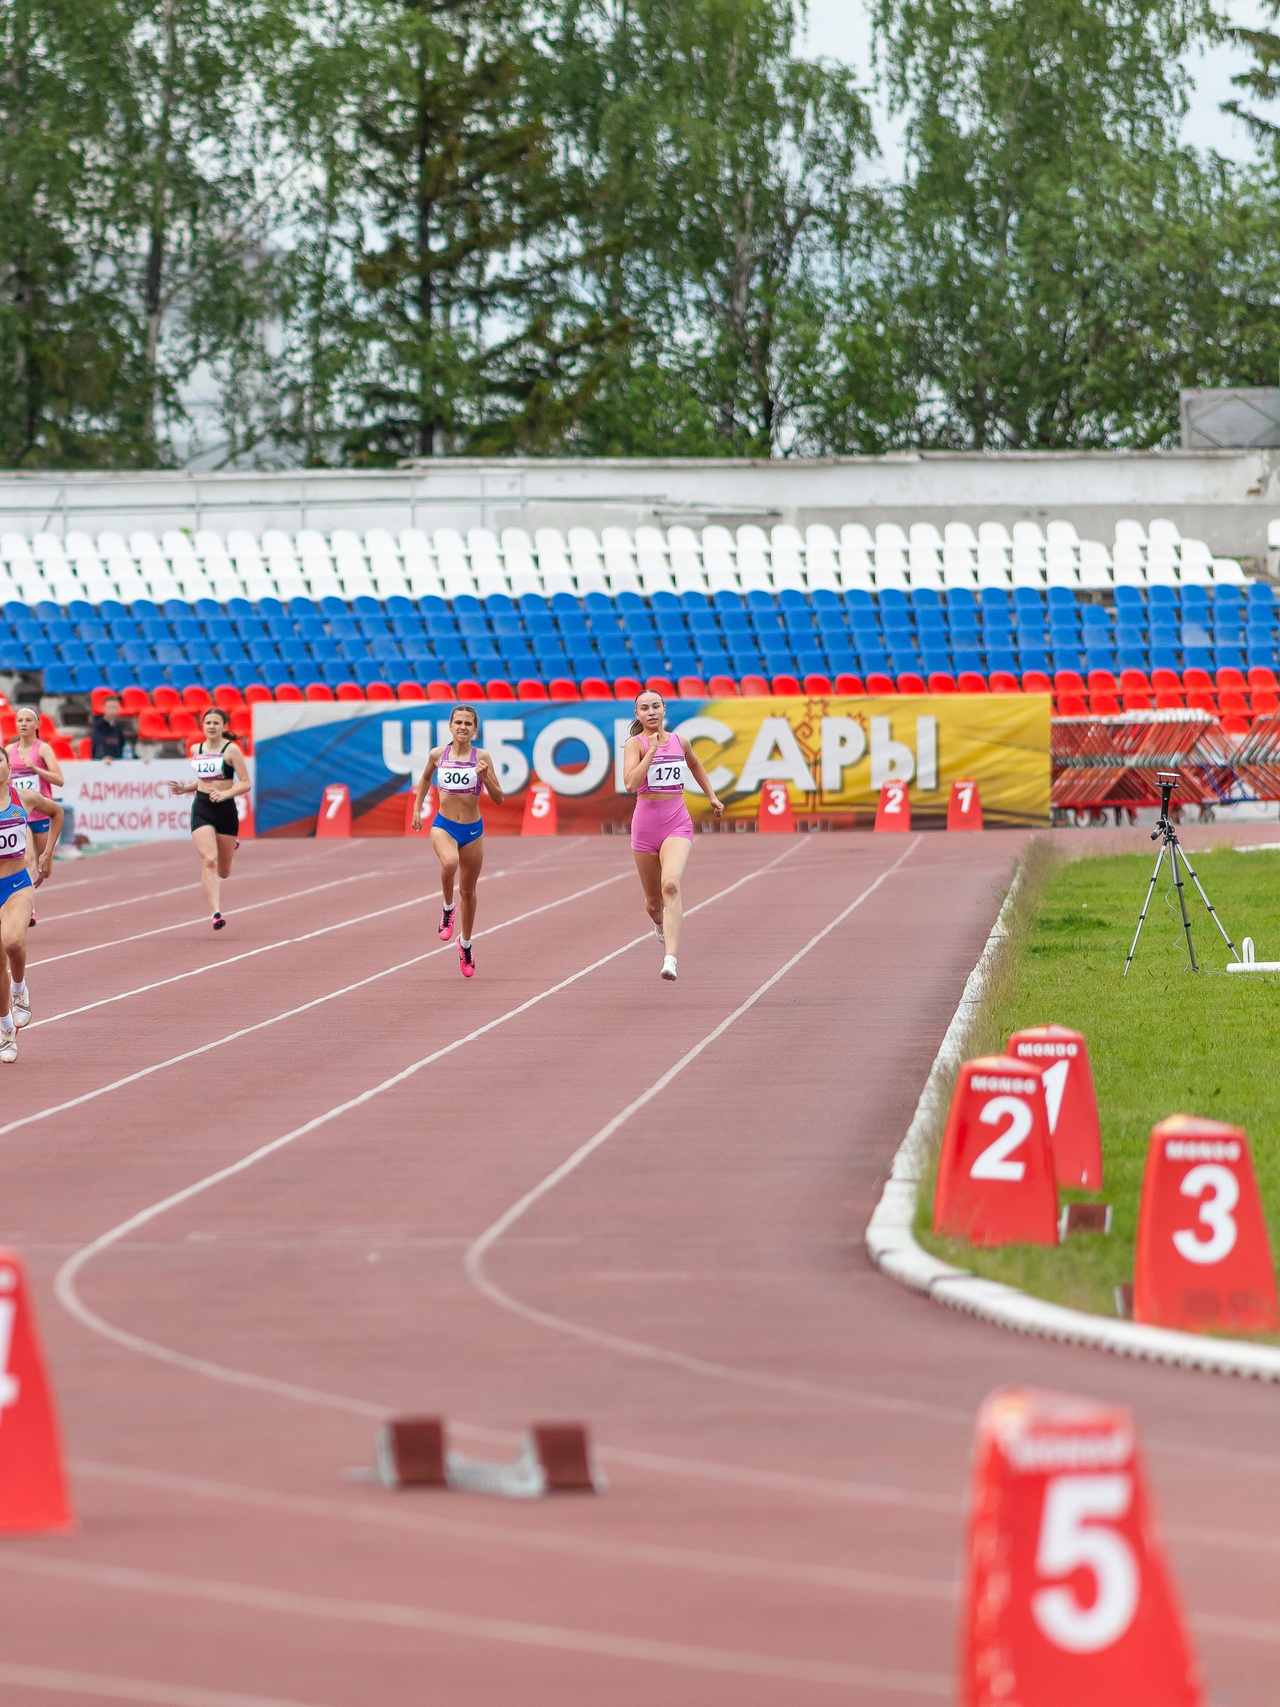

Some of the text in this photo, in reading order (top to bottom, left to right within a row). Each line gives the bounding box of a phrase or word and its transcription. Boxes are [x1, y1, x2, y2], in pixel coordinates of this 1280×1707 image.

[197, 763, 216, 773] 120
[444, 772, 470, 785] 306
[656, 767, 681, 780] 178
[326, 794, 344, 819] 7
[531, 792, 551, 818] 5
[768, 790, 786, 815] 3
[884, 789, 903, 813] 2
[958, 788, 973, 813] 1
[73, 806, 153, 830] АШСКОЙ
[1017, 1043, 1078, 1058] MONDO
[970, 1075, 1037, 1095] MONDO
[1042, 1059, 1070, 1136] 1
[970, 1095, 1033, 1182] 2
[1172, 1163, 1240, 1265] 3
[1030, 1470, 1142, 1655] 5
